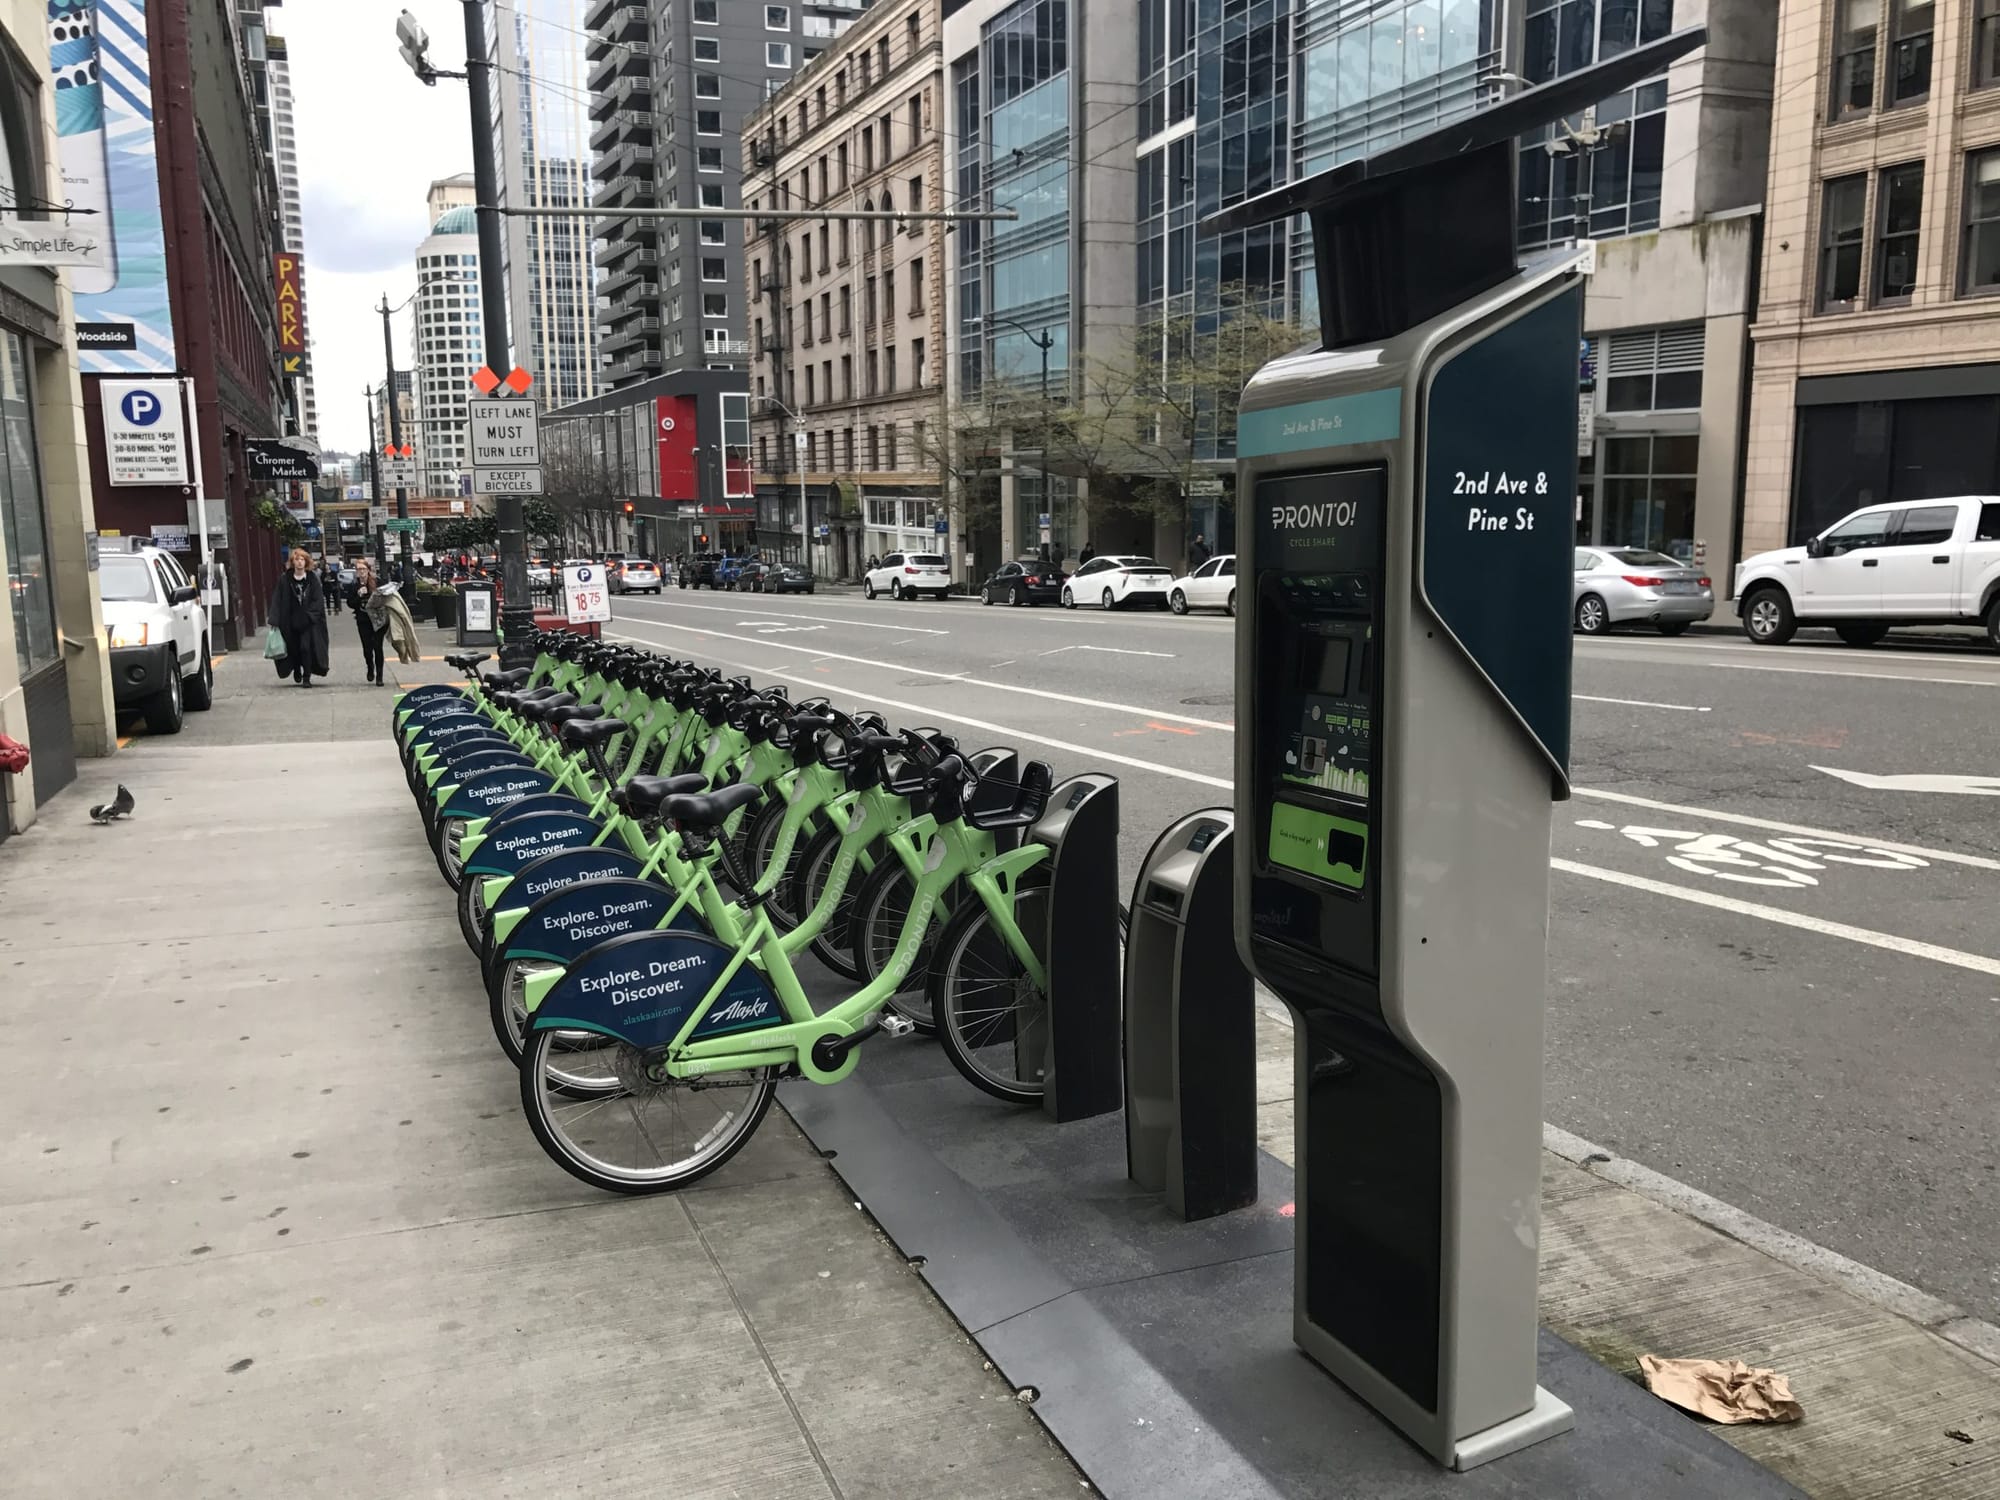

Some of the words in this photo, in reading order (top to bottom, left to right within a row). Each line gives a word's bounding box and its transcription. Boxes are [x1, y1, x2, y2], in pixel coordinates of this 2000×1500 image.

[13, 237, 51, 255] Simple
[54, 238, 74, 252] Life
[279, 258, 299, 345] PARK
[76, 331, 128, 342] Woodside
[131, 395, 153, 421] P
[475, 408, 500, 418] LEFT
[505, 407, 532, 418] LANE
[487, 426, 522, 439] MUST
[1282, 422, 1296, 436] 2nd
[1297, 421, 1309, 434] Ave
[1317, 417, 1332, 431] Pine
[1333, 415, 1343, 428] St
[128, 432, 155, 440] MINUTES
[255, 455, 295, 465] Chromer
[477, 447, 505, 457] TURN
[510, 446, 534, 457] LEFT
[272, 466, 307, 476] Market
[490, 471, 526, 481] EXCEPT
[485, 481, 532, 491] BICYCLES
[1453, 471, 1490, 495] 2nd
[1494, 471, 1528, 495] Ave
[1535, 471, 1548, 495] &
[1271, 501, 1357, 530] PRONTO!
[1468, 507, 1508, 531] Pine
[1515, 507, 1534, 530] St
[1289, 538, 1311, 547] CYCLE
[1313, 537, 1336, 546] SHARE
[580, 570, 590, 581] P
[420, 708, 445, 718] Explore.
[446, 706, 468, 714] Dream.
[468, 786, 506, 798] Explore.
[507, 779, 541, 791] Dream.
[495, 835, 540, 851] Explore.
[542, 827, 582, 842] Dream.
[516, 843, 567, 860] Discover.
[526, 876, 576, 895] Explore.
[578, 866, 624, 881] Dream.
[818, 851, 854, 922] PRONTO!
[543, 910, 599, 930] Explore.
[602, 899, 653, 918] Dream.
[570, 919, 633, 941] Discover.
[892, 893, 934, 978] PRONTO!
[580, 969, 646, 993] Explore.
[648, 955, 707, 977] Dream.
[611, 979, 684, 1006] Discover.
[623, 1006, 682, 1026] alaskaair.com
[710, 997, 768, 1024] Alaska
